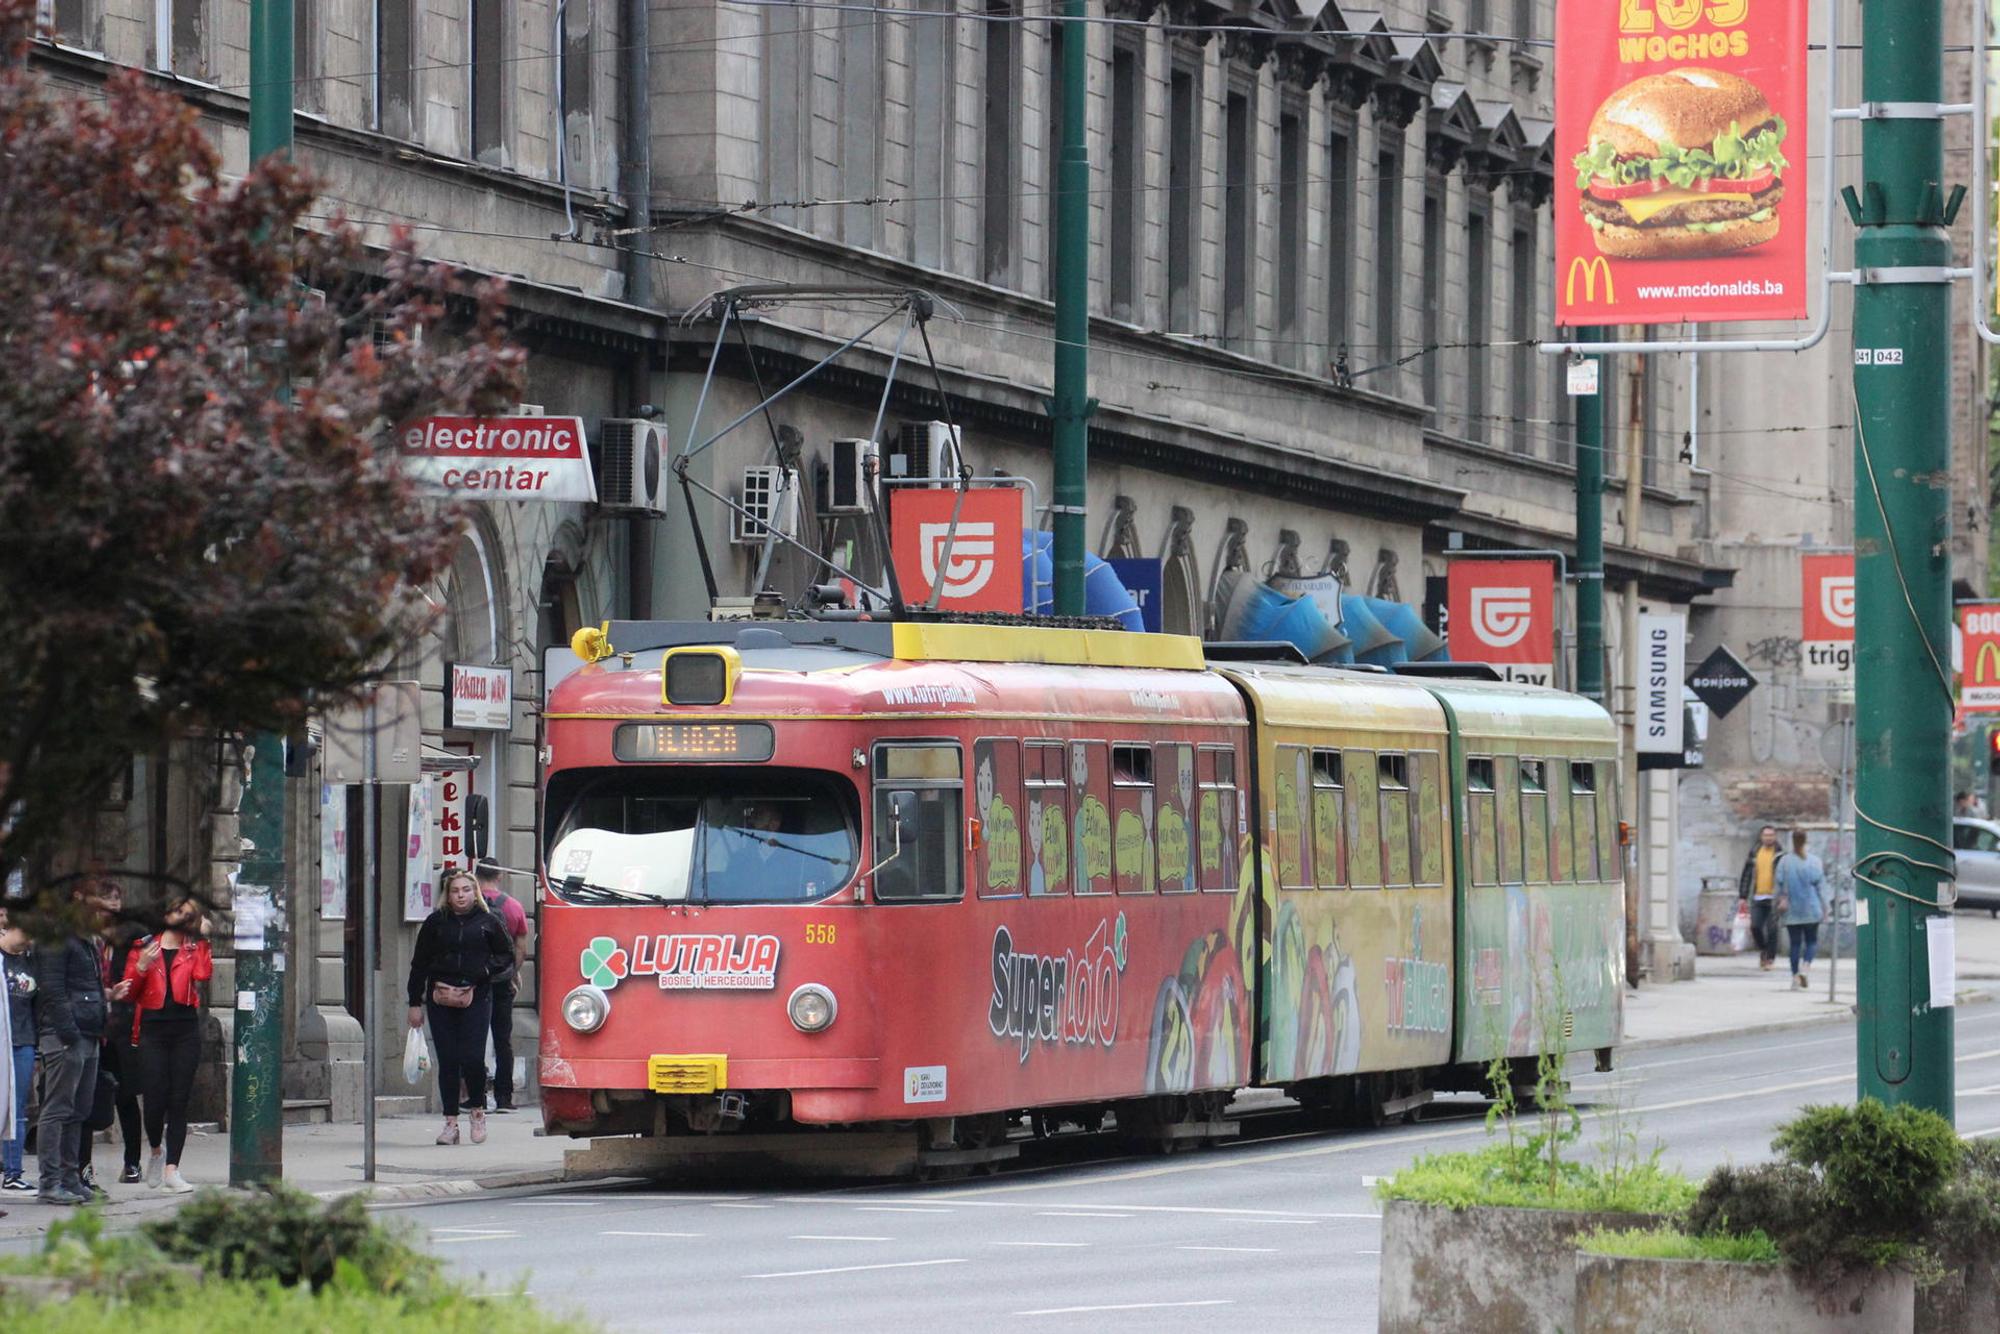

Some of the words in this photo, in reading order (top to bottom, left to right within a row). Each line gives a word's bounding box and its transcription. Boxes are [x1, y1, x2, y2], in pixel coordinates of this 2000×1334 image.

[1618, 30, 1749, 64] WOCHOS
[1637, 280, 1783, 299] www.mcdonalds.ba
[1877, 350, 1902, 362] 042
[405, 422, 571, 451] electronic
[443, 464, 549, 491] centar
[1650, 628, 1668, 738] SAMSUNG
[441, 771, 463, 870] eka
[805, 924, 836, 944] 558
[631, 934, 780, 974] LUTRIJA
[660, 976, 692, 987] BOSNE
[703, 976, 773, 987] HERCEGOVINE
